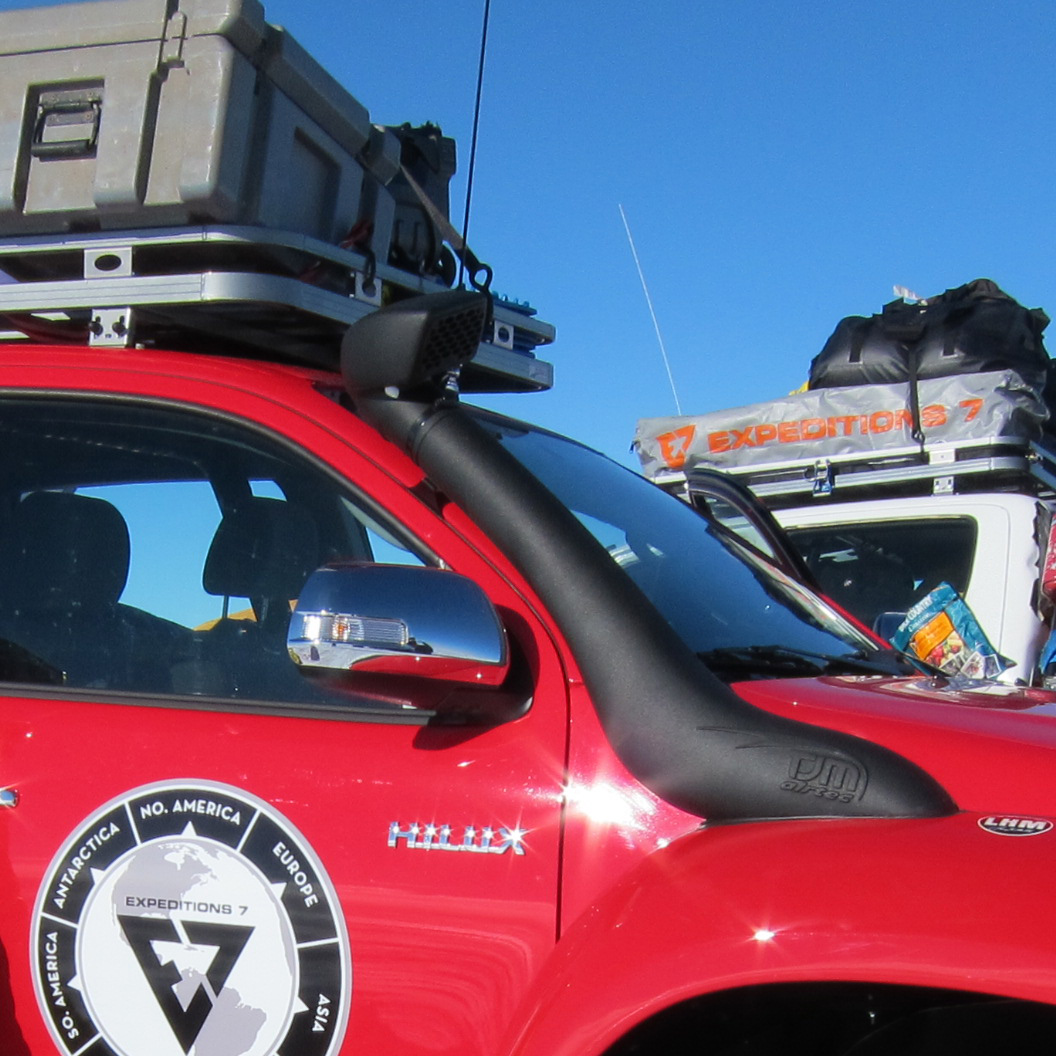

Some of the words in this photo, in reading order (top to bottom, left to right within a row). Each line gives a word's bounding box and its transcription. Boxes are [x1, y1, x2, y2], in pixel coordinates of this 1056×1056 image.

[707, 404, 947, 453] EXPEDITIONS
[959, 399, 984, 422] 7
[140, 802, 168, 820] NO.
[172, 800, 241, 826] AMERICA
[984, 817, 1046, 830] LHM
[387, 821, 525, 855] HILUX
[53, 822, 121, 909] ANTARCTICA
[272, 842, 319, 908] EUROPE
[125, 896, 232, 915] EXPEDITIONS
[238, 905, 249, 915] 7
[46, 931, 66, 1007] AMERICA
[60, 1007, 80, 1040] SO.
[312, 993, 331, 1034] ASIA
